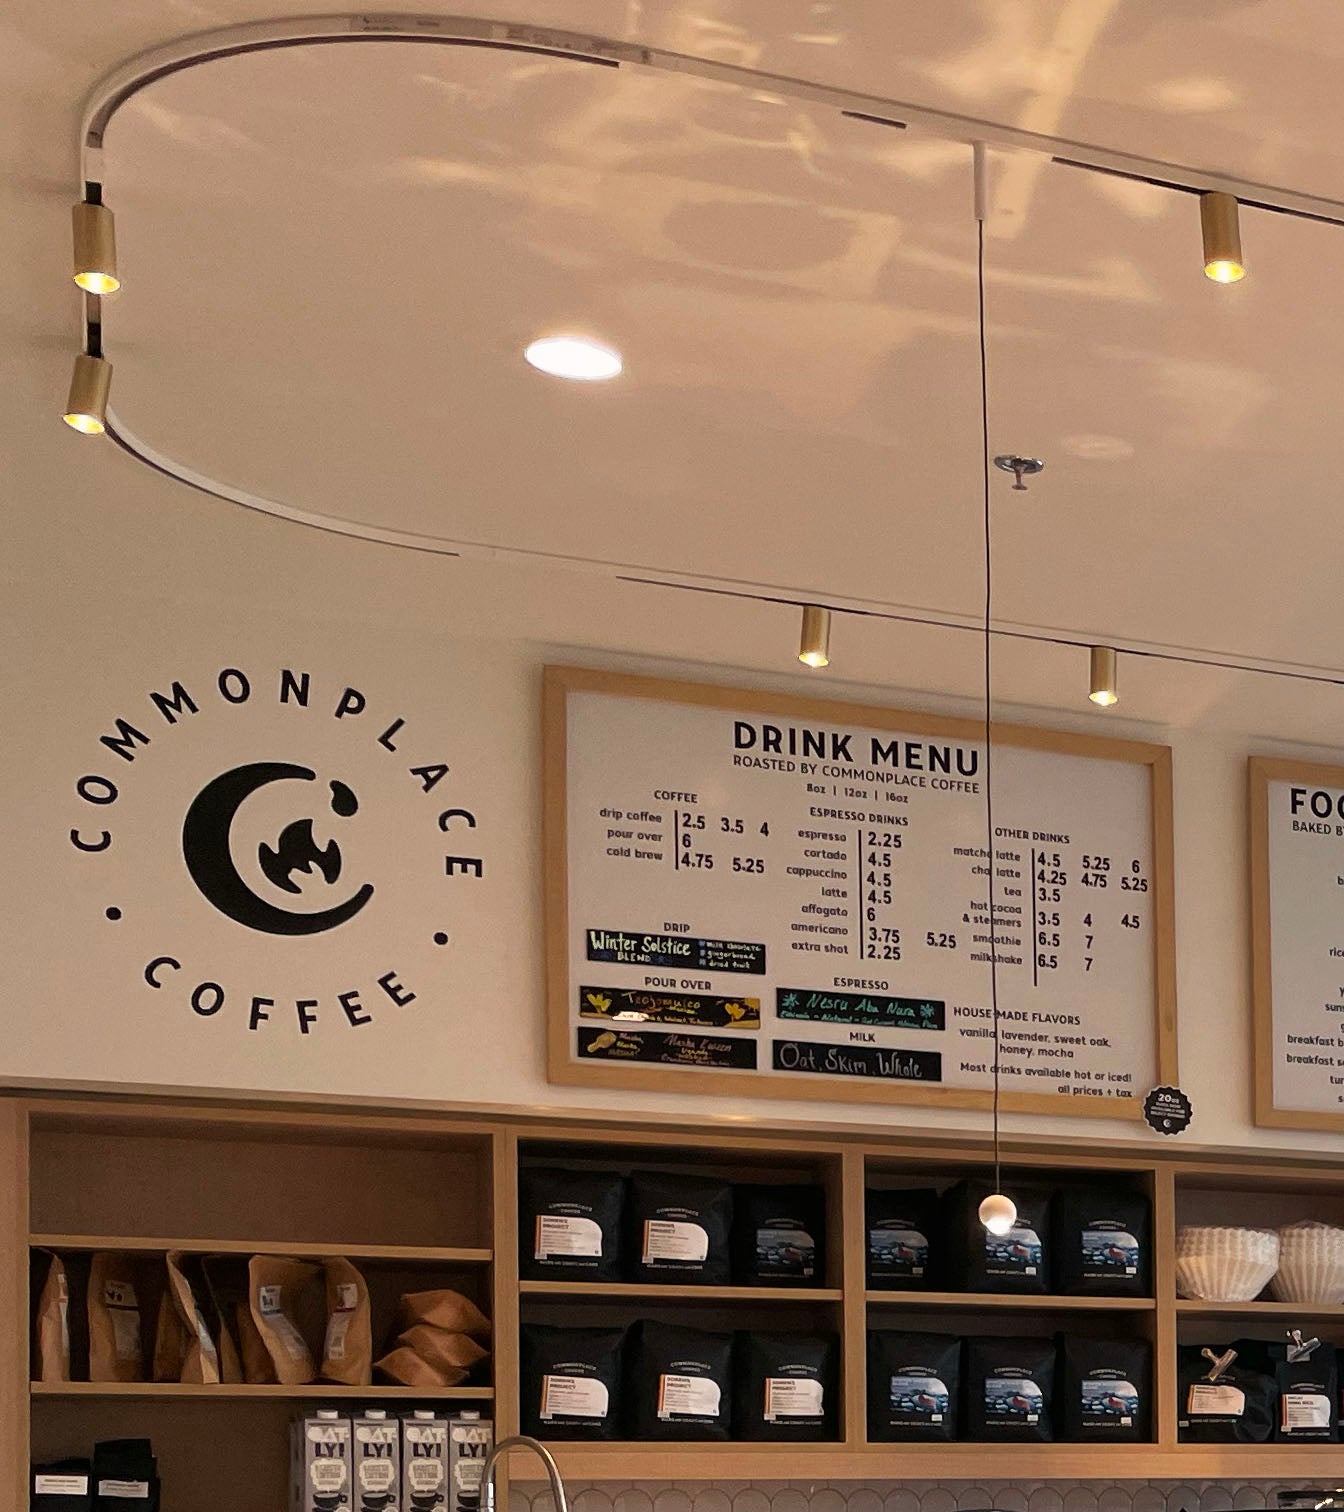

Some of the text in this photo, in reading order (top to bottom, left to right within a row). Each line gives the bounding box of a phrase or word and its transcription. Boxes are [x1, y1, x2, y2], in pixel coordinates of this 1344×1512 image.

[734, 721, 978, 777] DRINK MENU
[70, 668, 483, 879] COMMONPLACE
[733, 754, 980, 793] ROASTED BY COMMONPLACE COFFEE
[654, 789, 698, 803] COFFEE
[599, 808, 662, 823] drip coffee
[682, 812, 744, 834] 2.5 3.5
[809, 806, 909, 826] ESPRESSO DRINKS
[607, 827, 663, 842] pour over
[1292, 820, 1332, 835] BAKED
[797, 829, 847, 842] espresso
[867, 831, 902, 848] 2.25
[994, 827, 1070, 844] OTHER DRINKS
[606, 846, 663, 861] cold brew
[804, 848, 847, 861] cortado
[867, 852, 891, 867] 4.5
[996, 850, 1021, 862] latte
[1037, 851, 1110, 871] 4.5 5.25
[680, 851, 765, 873] 4.75 5.25
[786, 865, 848, 880] cappuccino
[866, 871, 892, 887] 4.5
[996, 867, 1021, 878] latte
[1037, 869, 1148, 893] 4.25 4.75 5.25
[821, 886, 848, 898] latte
[867, 889, 892, 904] 4.5
[1004, 886, 1022, 897] tea
[1038, 887, 1061, 903] 3.5
[801, 903, 848, 917] affogato
[970, 901, 988, 911] hot
[867, 907, 876, 922] 6
[1038, 911, 1140, 929] 3.5 4.5
[663, 922, 690, 933] DRIP
[791, 922, 849, 935] americano
[589, 930, 637, 951] Winter
[641, 936, 692, 956] Solstice
[869, 926, 957, 949] 3.75 5.25
[1038, 931, 1060, 947] 6.5
[791, 941, 849, 955] extra shot
[867, 945, 901, 961] 2.25
[617, 951, 651, 963] BLEND
[1038, 954, 1058, 969] 6.5
[645, 976, 712, 991] POUR OVER
[833, 977, 889, 990] ESPRESSO
[144, 955, 416, 1034] COFFEE
[1032, 1012, 1081, 1025] FLAVORS
[849, 1031, 876, 1043] MILK
[1054, 1034, 1087, 1046] sweet
[1287, 1034, 1335, 1047] breakfast
[1038, 1046, 1074, 1058] mocha
[1286, 1053, 1335, 1066] breakfast
[876, 1051, 923, 1078] Whole
[960, 1062, 1092, 1080] Most available hot
[1073, 1086, 1103, 1098] prices
